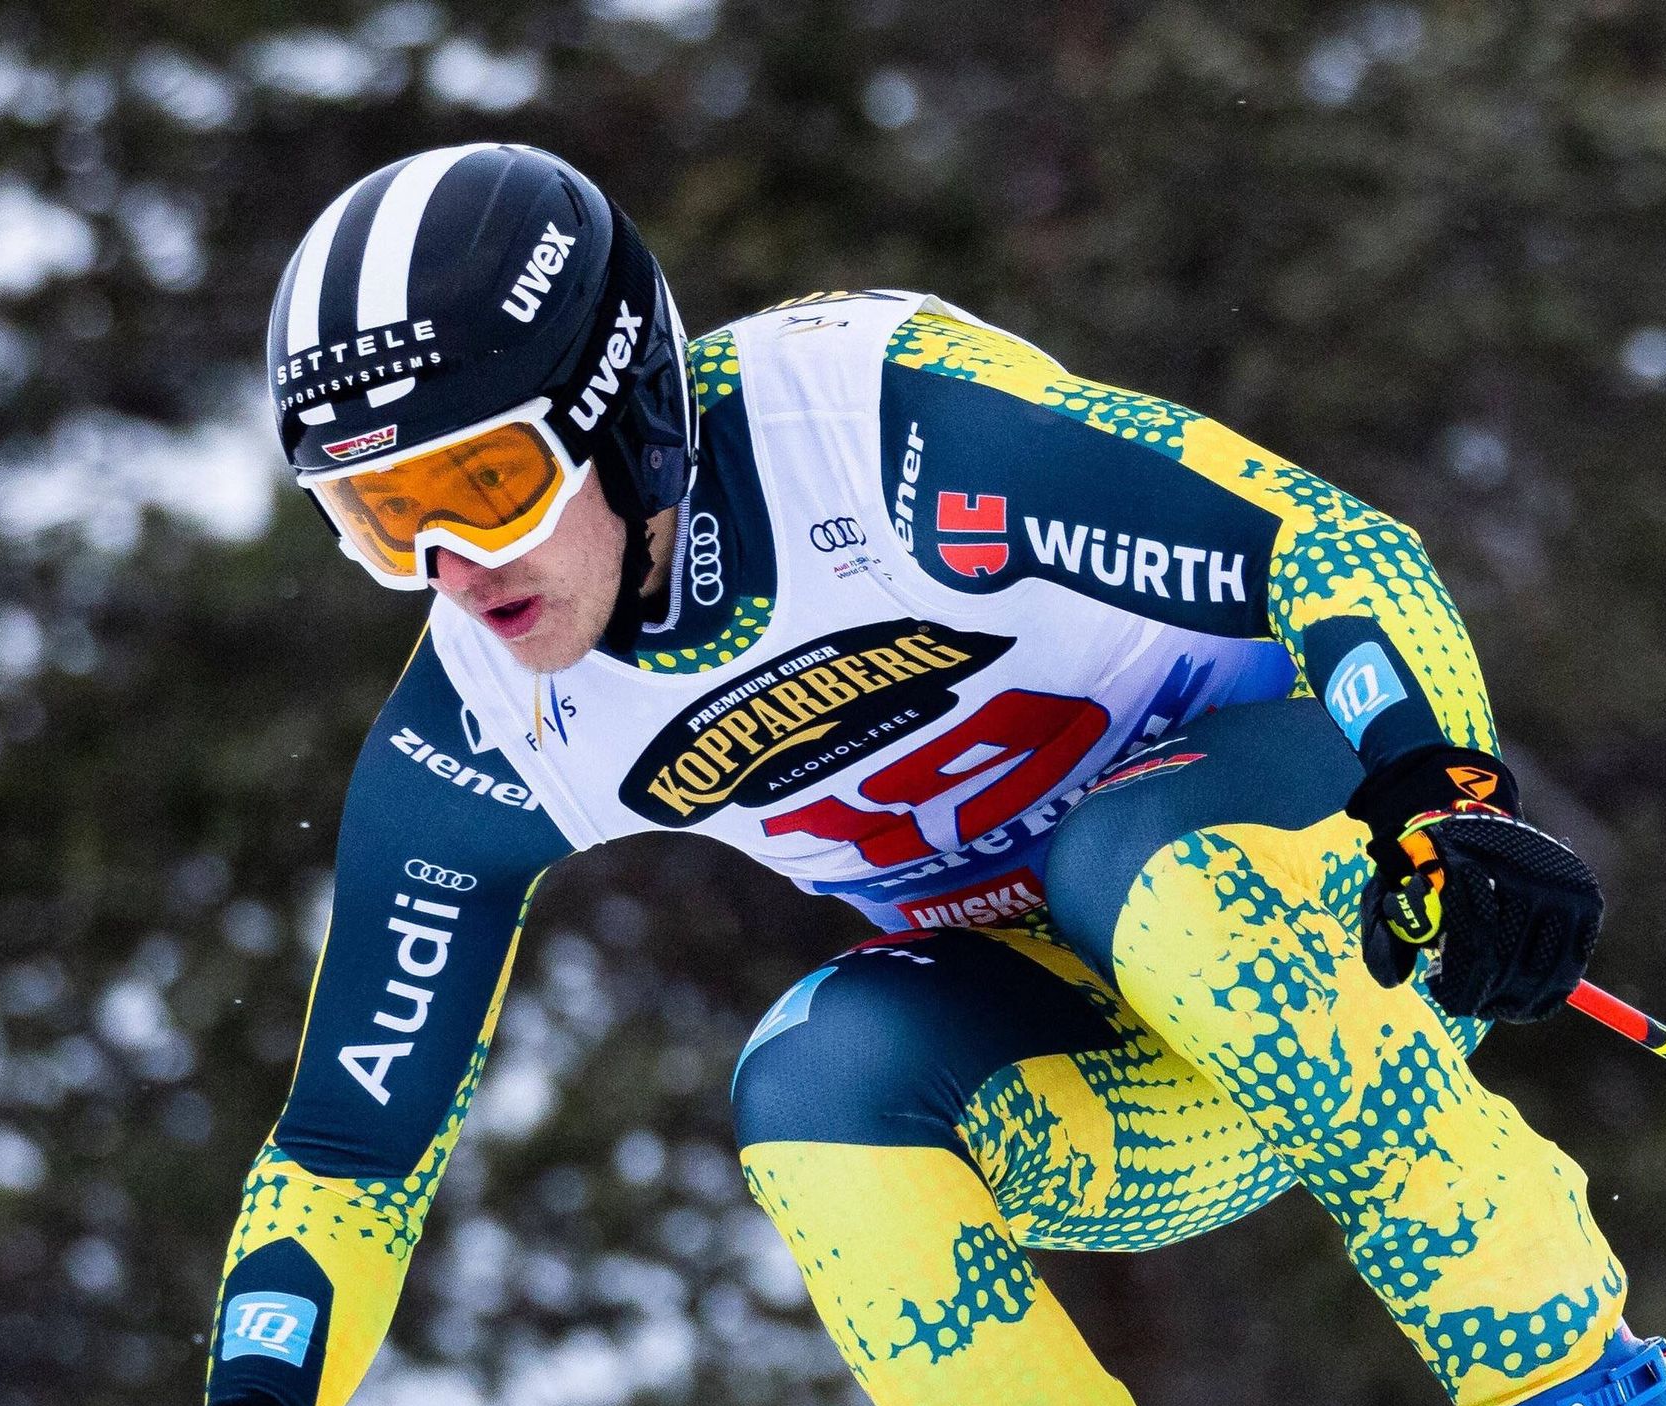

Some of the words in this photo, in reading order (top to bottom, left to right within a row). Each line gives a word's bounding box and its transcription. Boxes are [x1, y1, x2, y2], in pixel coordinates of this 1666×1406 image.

[501, 221, 576, 323] uvex
[277, 319, 436, 386] SETTELE
[280, 352, 442, 412] SPORTSYSTEMS
[568, 299, 643, 432] uvex
[1023, 516, 1247, 603] WÜRTH
[646, 634, 972, 817] KOPPARBERG
[686, 671, 778, 733] PREMIUM
[778, 645, 840, 677] CIDER
[767, 708, 921, 792] ALCOHOL-FREE
[911, 881, 1043, 929] HUSKI
[1395, 893, 1421, 930] LEKI
[337, 892, 461, 1107] Audi
